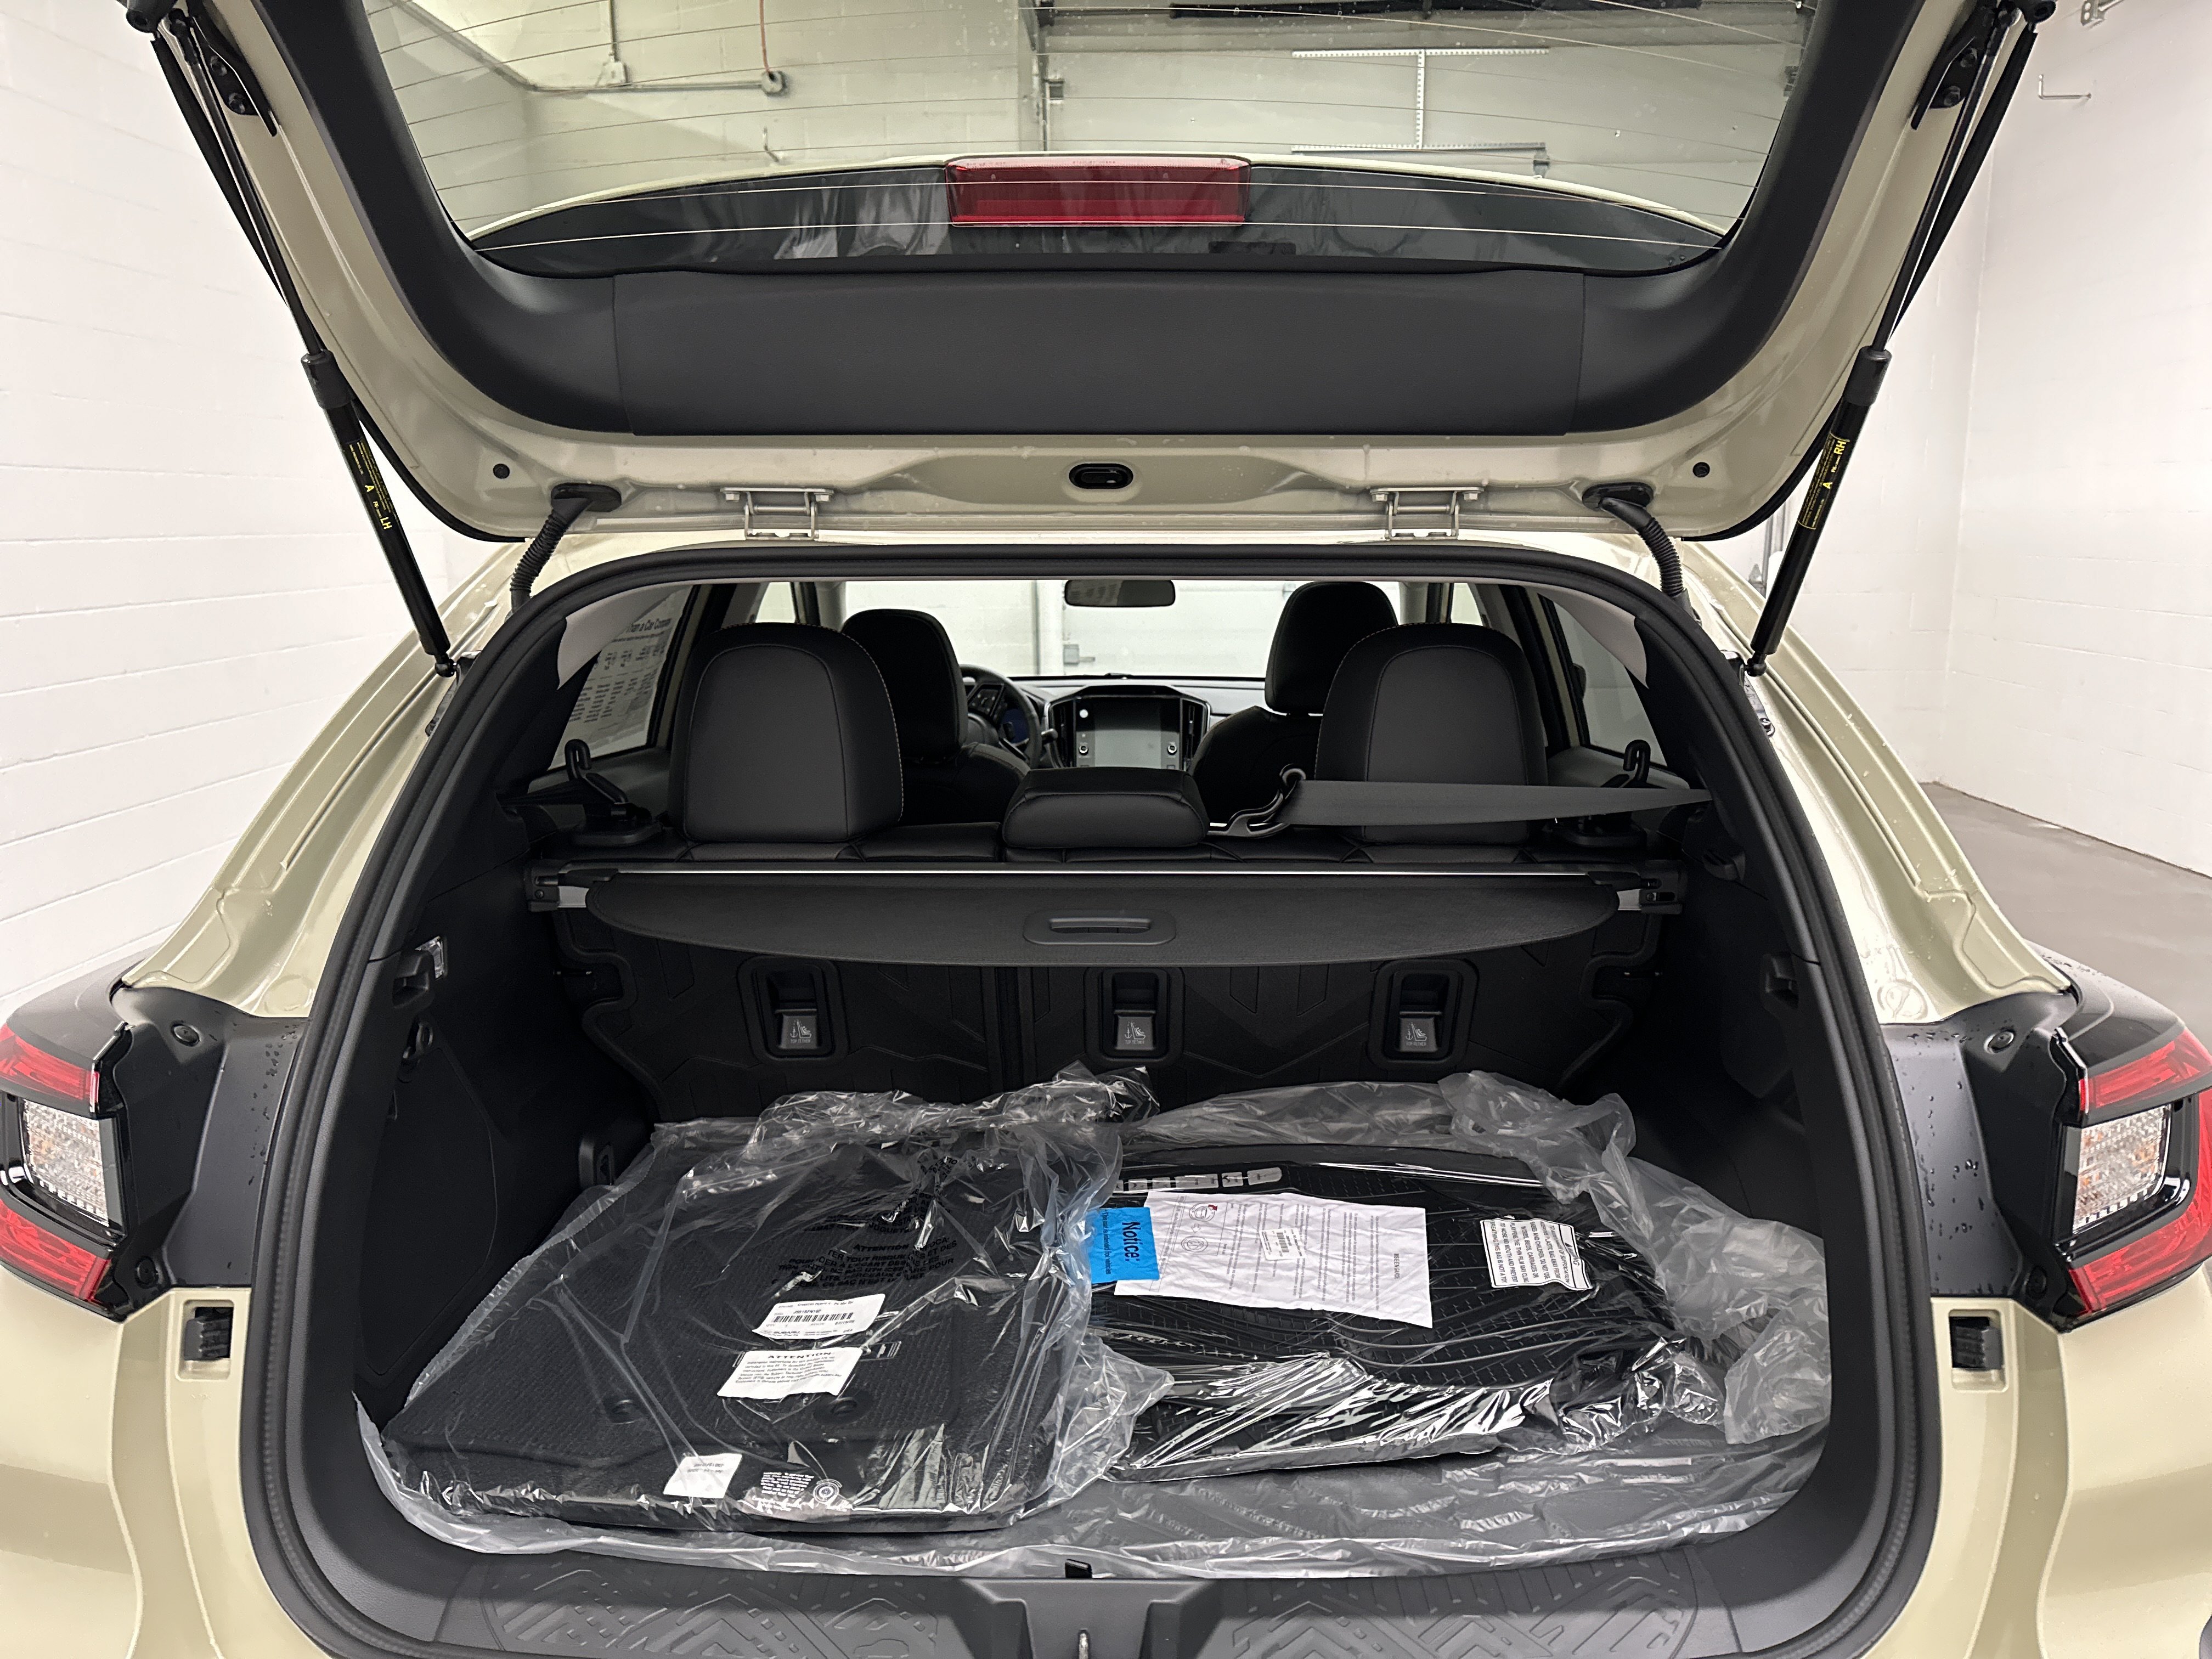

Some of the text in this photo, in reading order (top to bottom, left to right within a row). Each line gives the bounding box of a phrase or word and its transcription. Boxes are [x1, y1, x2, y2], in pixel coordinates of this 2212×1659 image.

[1833, 441, 1847, 455] RH
[380, 517, 392, 529] LH
[1122, 1221, 1143, 1261] Notice:
